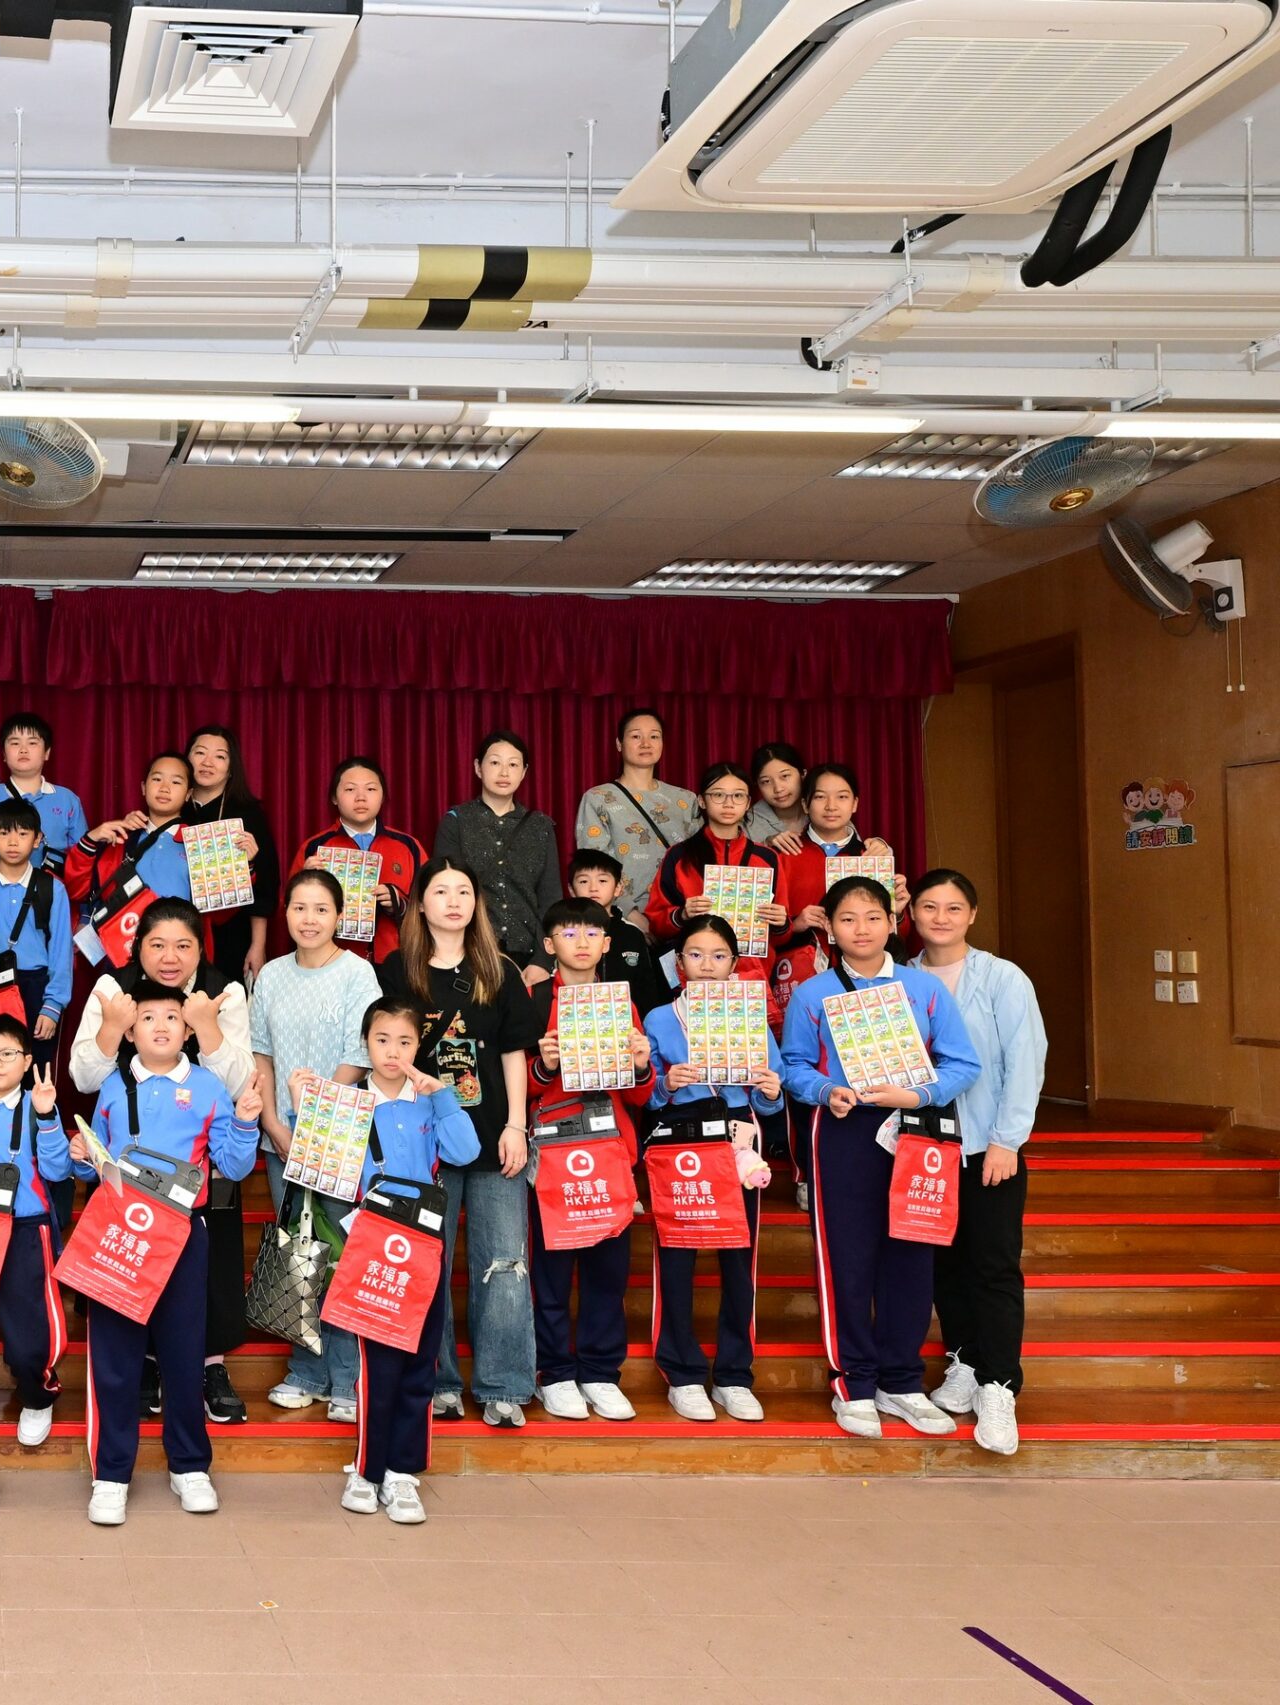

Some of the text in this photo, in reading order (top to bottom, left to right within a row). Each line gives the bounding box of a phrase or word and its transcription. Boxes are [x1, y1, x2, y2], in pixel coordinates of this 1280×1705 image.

[1126, 825, 1193, 848] 請安靜閱讀
[561, 1178, 608, 1196] 家福會
[671, 1180, 712, 1195] 家福會
[911, 1175, 947, 1193] 家福會
[564, 1193, 611, 1207] HKFWS
[673, 1194, 716, 1206] HKFWS
[907, 1189, 944, 1203] HKFWS
[105, 1223, 152, 1257] 家福會
[99, 1237, 145, 1267] HKFWS
[366, 1260, 412, 1287] 家福會
[361, 1274, 407, 1298] HKFWS
